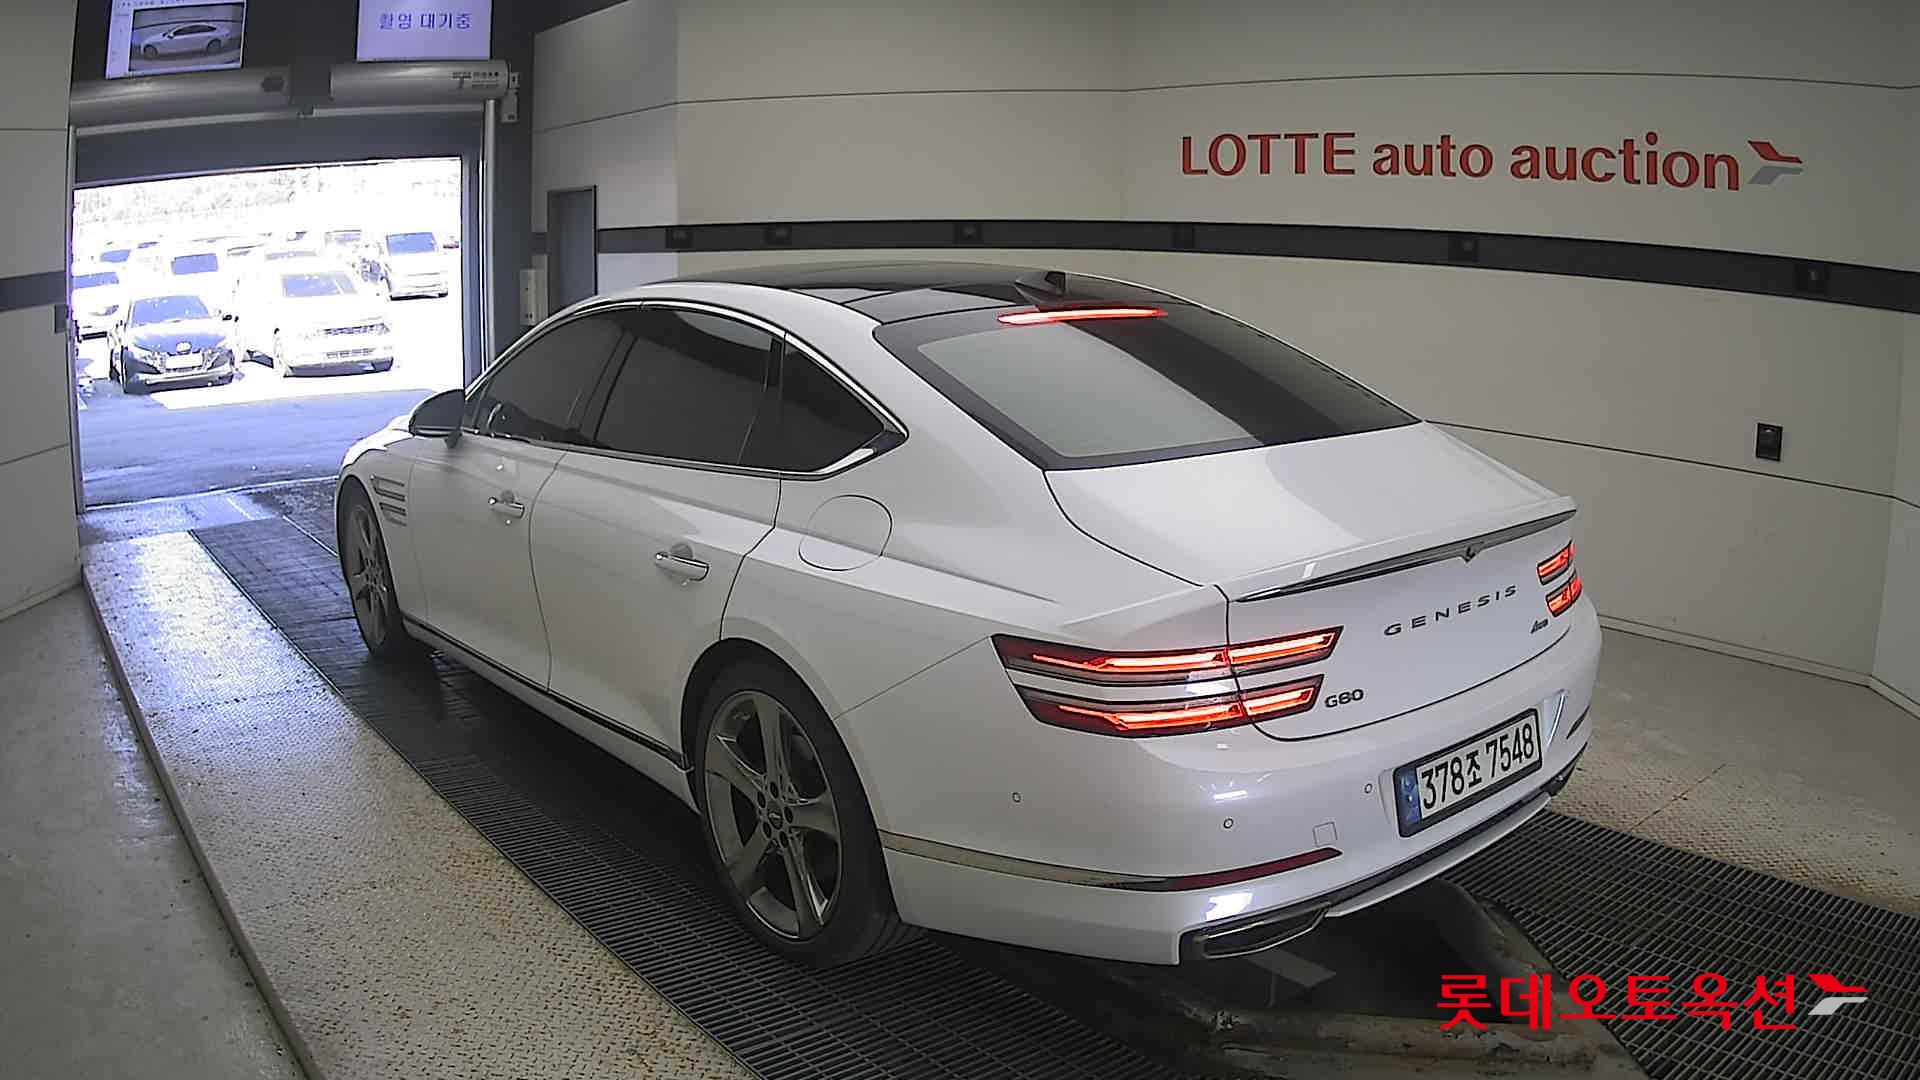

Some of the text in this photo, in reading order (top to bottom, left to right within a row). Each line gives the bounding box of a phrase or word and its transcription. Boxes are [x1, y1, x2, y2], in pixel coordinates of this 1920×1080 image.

[420, 13, 471, 30] 대기중
[1180, 131, 1740, 191] LOTTE auto auction
[1384, 585, 1516, 636] GENESIS
[1325, 688, 1364, 708] G80
[1421, 723, 1534, 810] 378조 7548
